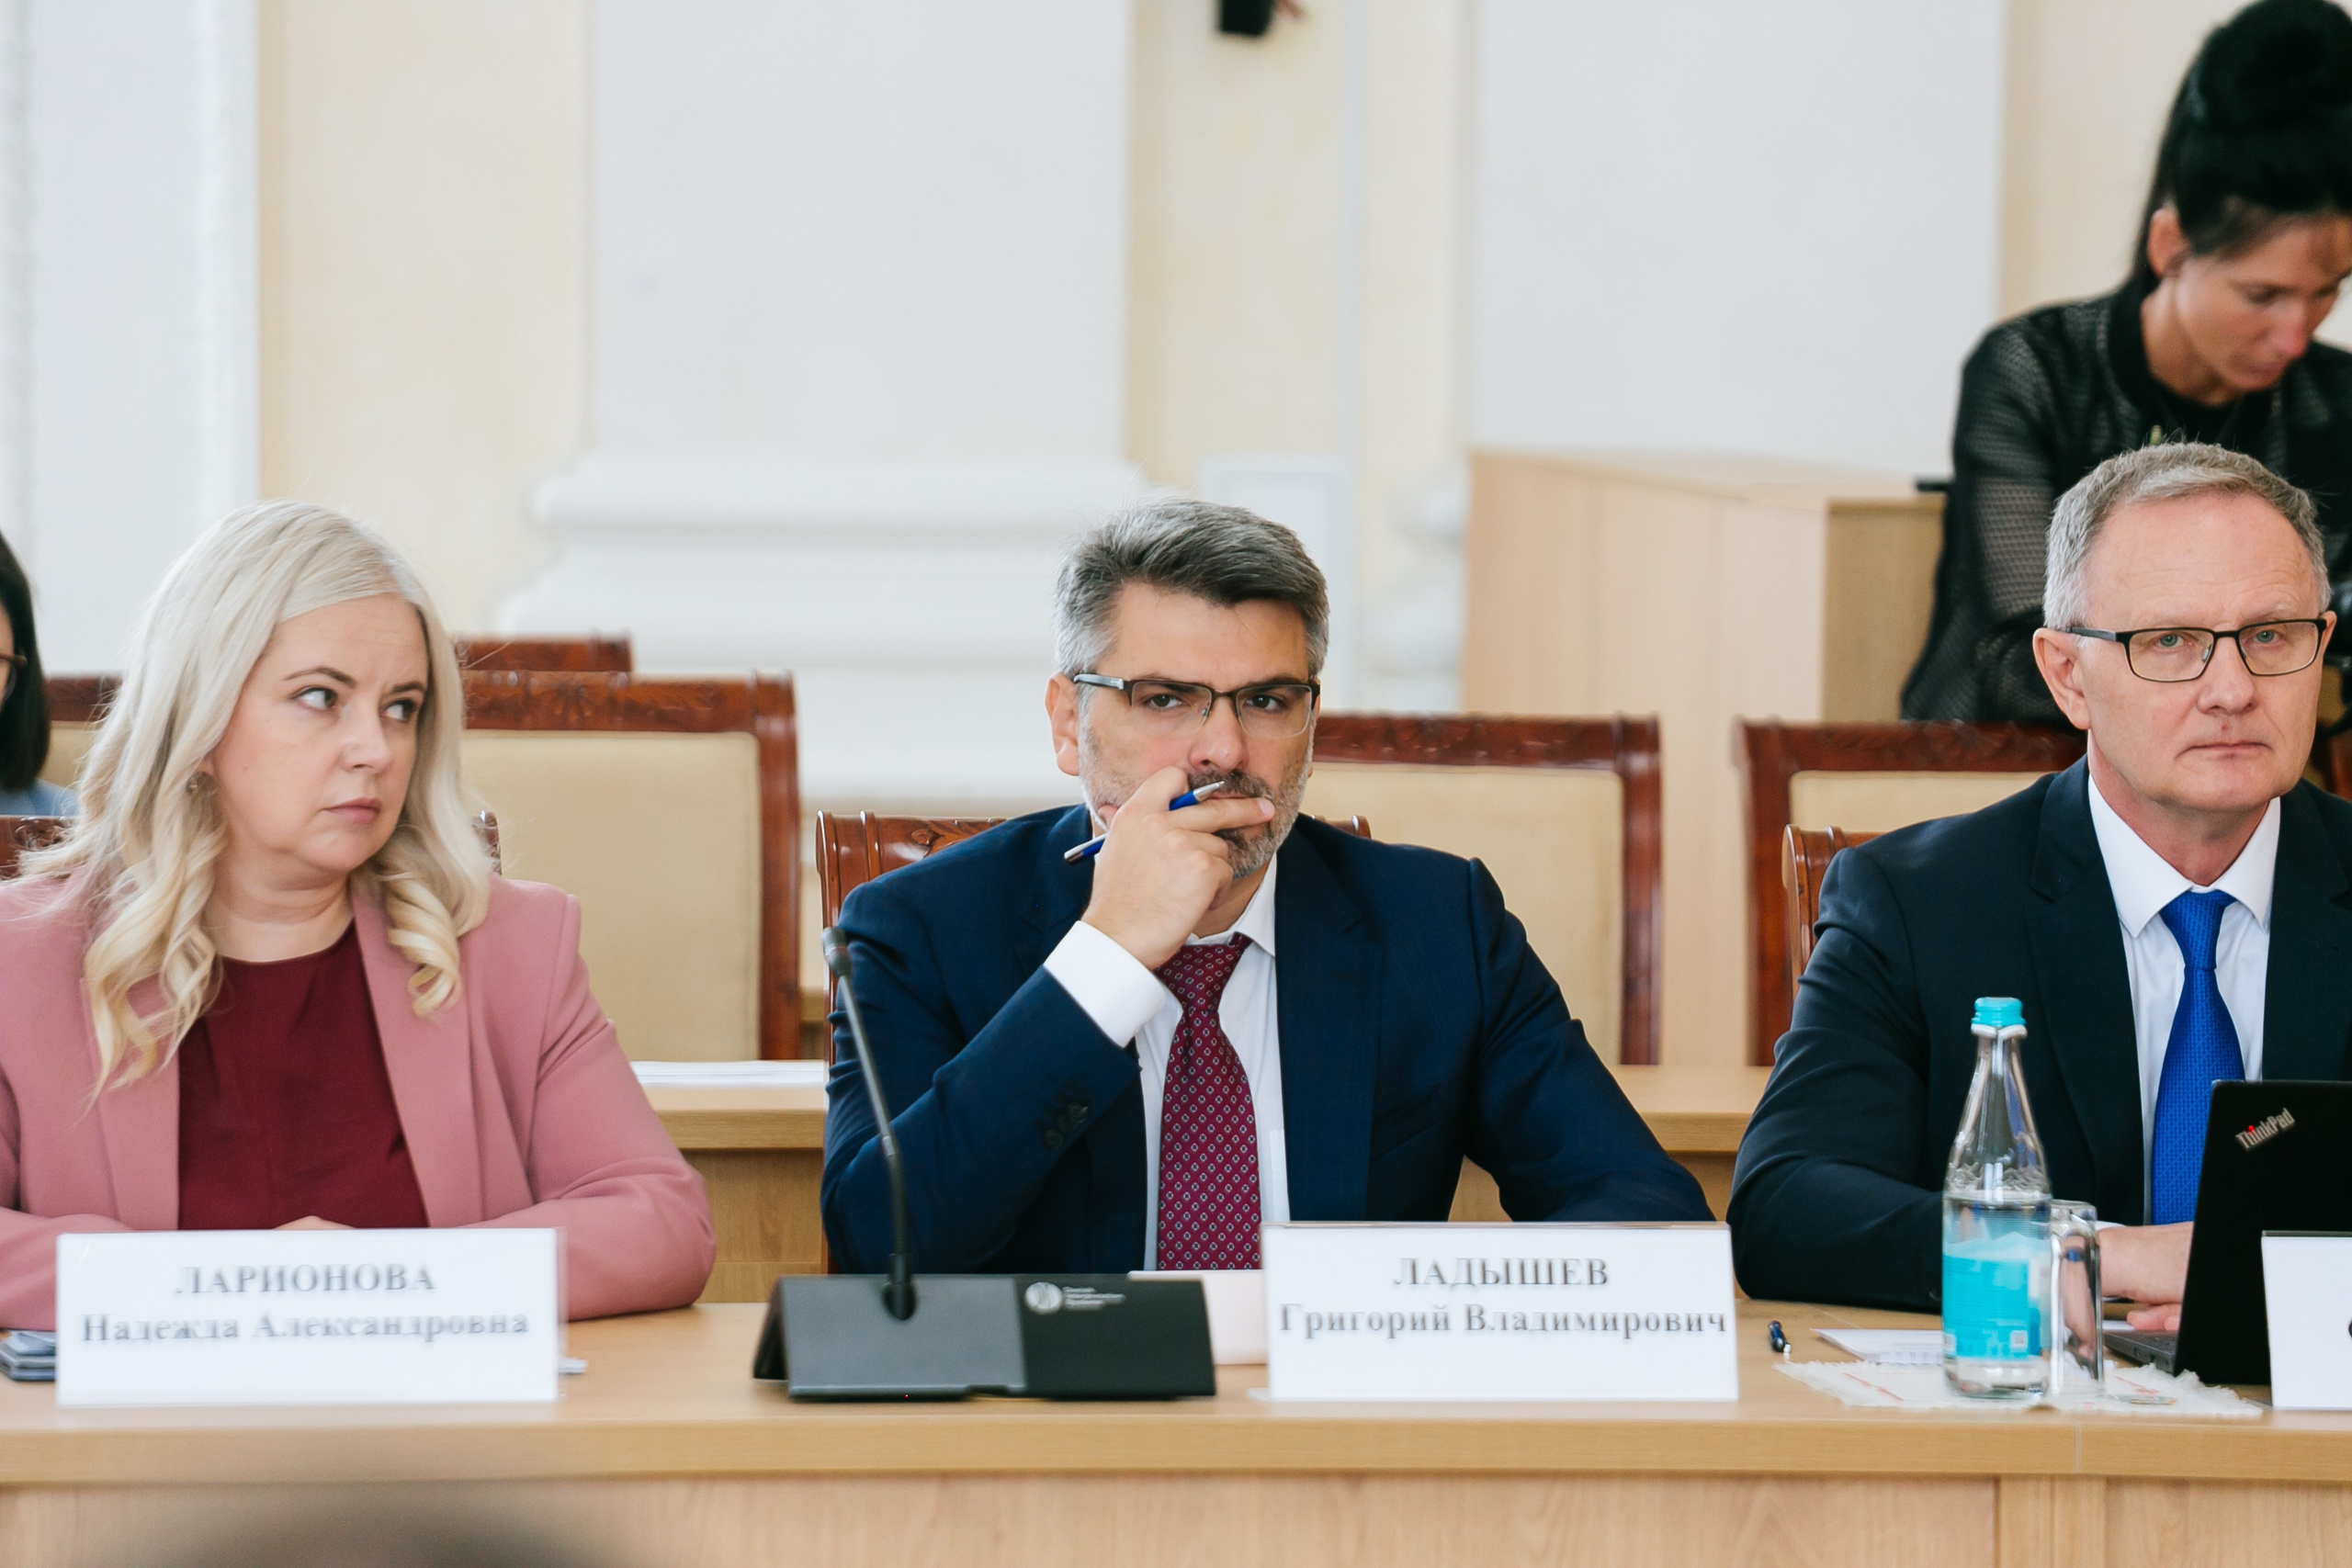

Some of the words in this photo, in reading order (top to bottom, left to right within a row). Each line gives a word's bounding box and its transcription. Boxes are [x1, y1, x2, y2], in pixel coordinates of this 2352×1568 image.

[2235, 1107, 2295, 1149] ThinkPad
[175, 1264, 435, 1294] ЛАРИОНОВА
[1394, 1258, 1609, 1290] ЛАДЫШЕВ
[83, 1314, 240, 1343] Надежда
[253, 1314, 529, 1344] Александровна
[1280, 1303, 1452, 1340] Григорий
[1464, 1303, 1727, 1340] Владимирович
